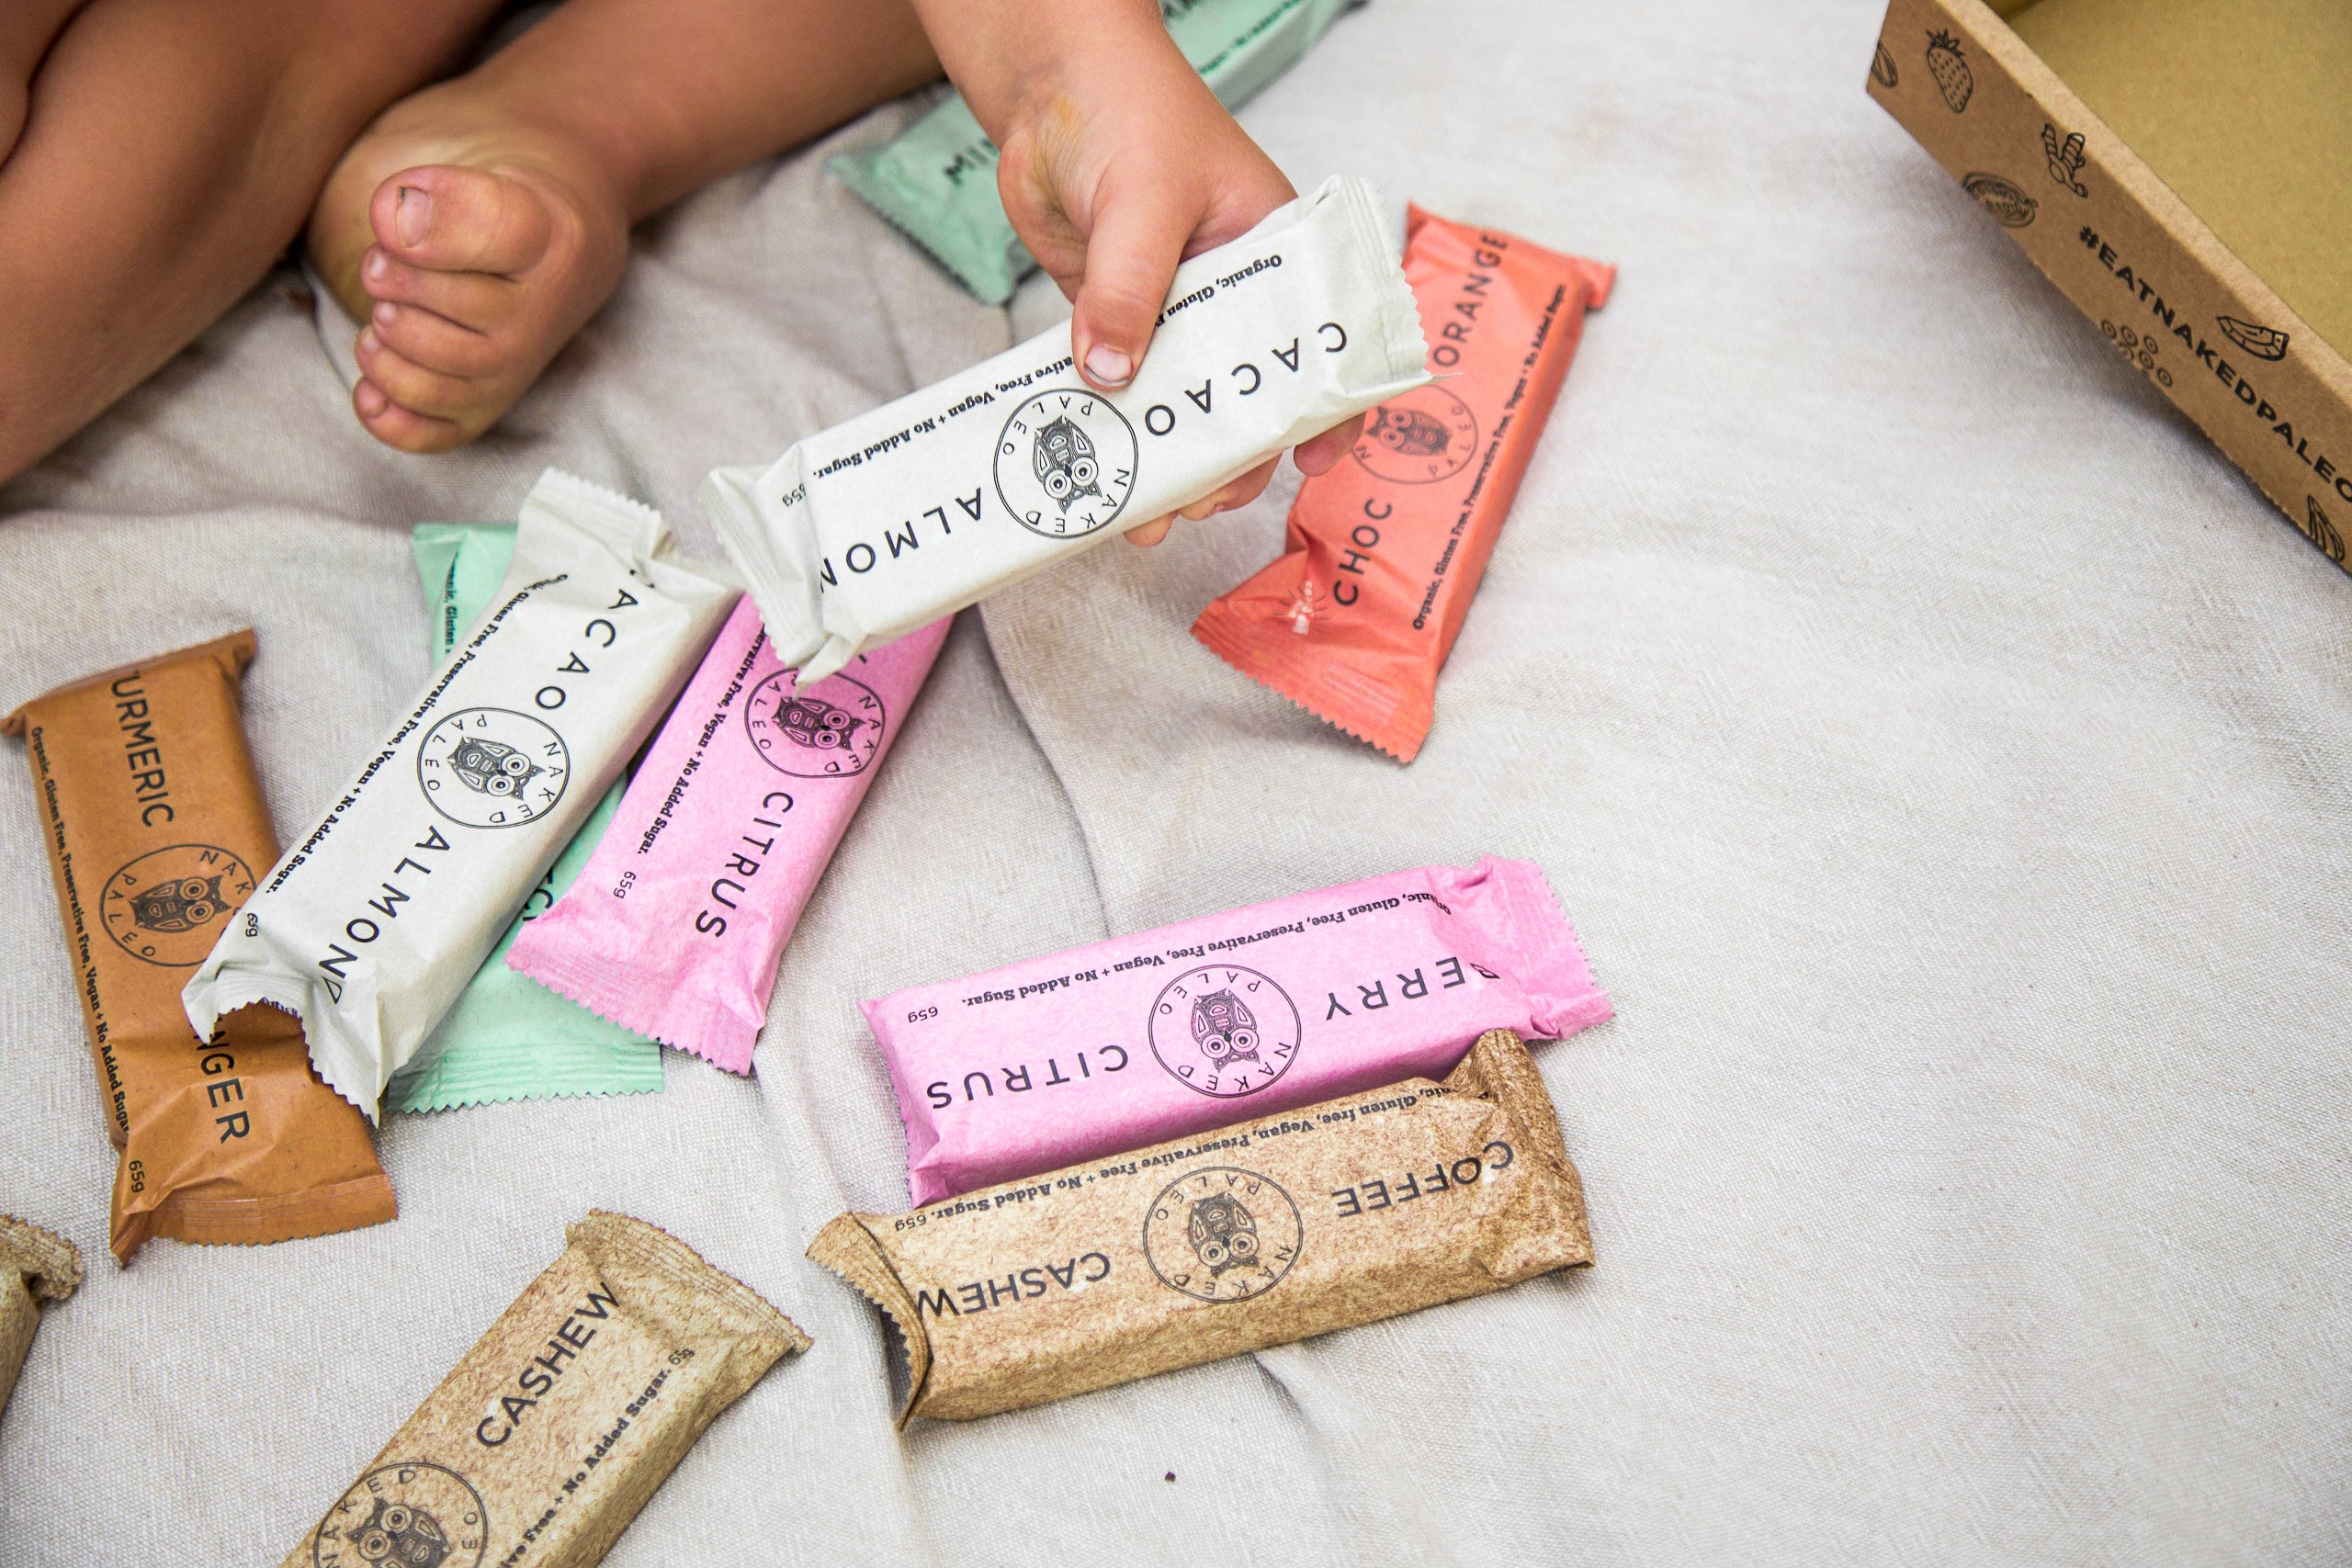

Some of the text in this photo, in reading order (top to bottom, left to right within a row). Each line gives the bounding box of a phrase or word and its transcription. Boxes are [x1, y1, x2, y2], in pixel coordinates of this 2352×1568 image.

[1166, 254, 1283, 317] Organic, Gluten
[1431, 233, 1508, 367] ORANGE
[1144, 321, 1348, 436] CACAO
[2078, 225, 2352, 503] #EATNAKEDPALEO
[812, 373, 1034, 479] Free, Vegan + No Added Sugar.
[1001, 395, 1093, 455] PALEO
[1024, 468, 1134, 534] NAKED
[1332, 499, 1392, 607] CHOC
[492, 592, 529, 622] Gluten
[1411, 581, 1440, 630] Organic,
[468, 623, 499, 649] Free,
[413, 649, 476, 718] Preservative
[717, 680, 743, 708] Free,
[387, 718, 419, 746] Free,
[697, 713, 727, 748] Vegan
[823, 694, 882, 777] NAKED
[31, 726, 51, 776] Organic,
[356, 750, 396, 785] Vegan
[424, 713, 487, 791] PALEO
[682, 757, 701, 776] No
[44, 778, 60, 822] Gluten
[488, 741, 565, 828] NAKED
[659, 775, 690, 818] Added
[334, 795, 356, 813] No
[53, 820, 66, 855] Free,
[300, 813, 339, 854] Added
[637, 816, 668, 854] Sugar.
[265, 853, 306, 894] Sugar.
[695, 791, 794, 938] CITRUS
[61, 852, 85, 934] Preservative
[612, 870, 637, 899] 65g
[107, 873, 156, 960] PALEO
[1306, 910, 1346, 926] Free,
[1347, 897, 1400, 917] Gluten
[77, 933, 91, 969] Free,
[1165, 944, 1205, 959] Free,
[1207, 920, 1306, 952] Preservative
[1074, 968, 1099, 982] No
[1101, 968, 1110, 976] +
[1112, 954, 1166, 972] Vegan
[85, 965, 100, 1012] Vegan
[961, 988, 1016, 1007] Sugar.
[1017, 975, 1070, 999] Added
[1159, 970, 1261, 1015] PALEO
[95, 1021, 108, 1043] No
[907, 1006, 938, 1023] 65g
[100, 1043, 122, 1091] Added
[195, 1027, 251, 1144] NGER
[926, 1044, 1128, 1110] CITRUS
[1176, 1042, 1295, 1094] NAKED
[1316, 1108, 1356, 1124] free,
[1358, 1095, 1419, 1115] Gluten
[1251, 1119, 1316, 1139] Vegan,
[1140, 1134, 1250, 1168] Preservative
[128, 1159, 145, 1193] 65g
[1056, 1175, 1082, 1190] No
[1086, 1174, 1096, 1183] +
[1099, 1161, 1138, 1179] Free
[1329, 1139, 1514, 1219] COFFEE
[930, 1198, 990, 1220] Sugar.
[993, 1182, 1051, 1209] Added
[1154, 1173, 1261, 1221] PALEO
[894, 1213, 927, 1232] 65g
[917, 1251, 1111, 1321] CASHEW
[1172, 1245, 1294, 1297] NAKED
[475, 1280, 621, 1449] CASHEW
[667, 1348, 695, 1365] 65g
[522, 1369, 672, 1543] Free + No Added Sugar.
